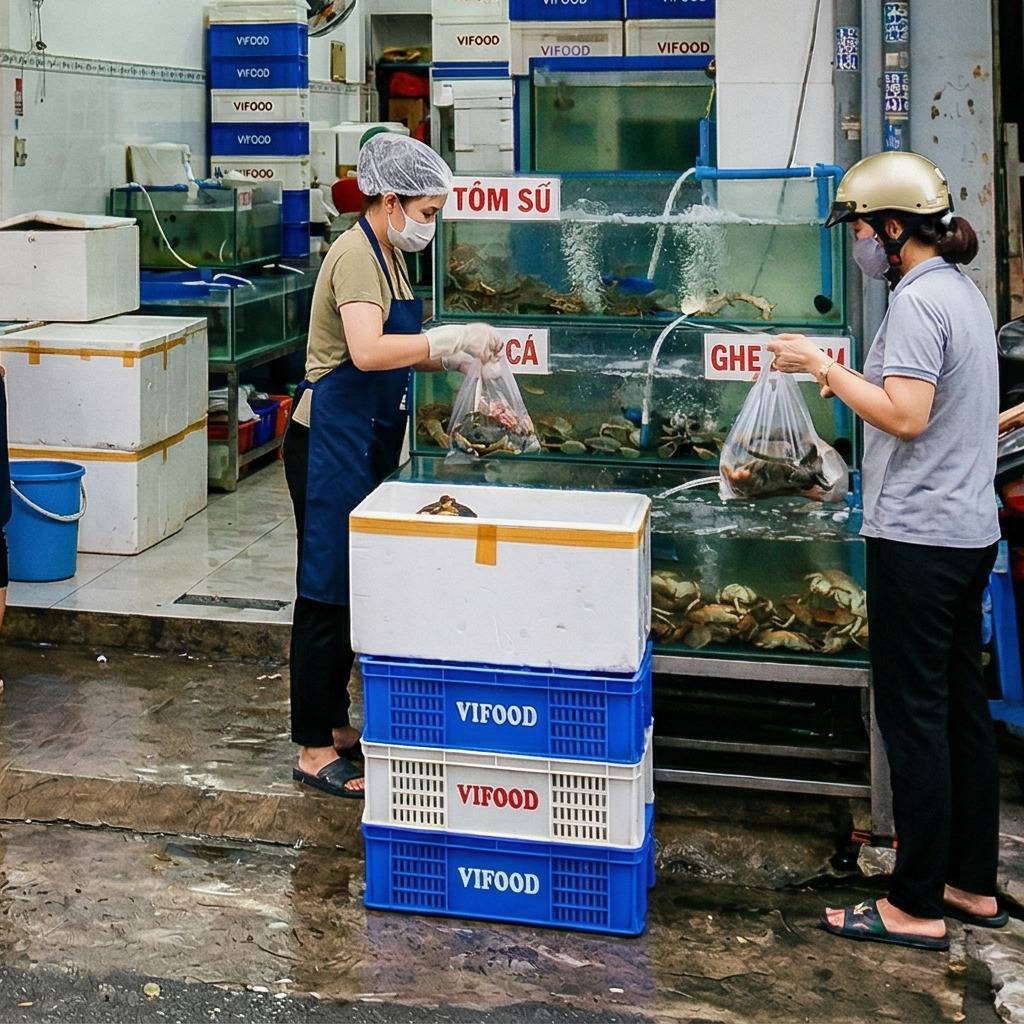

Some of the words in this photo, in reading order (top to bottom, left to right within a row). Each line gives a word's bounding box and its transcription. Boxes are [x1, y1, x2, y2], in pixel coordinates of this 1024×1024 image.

[456, 35, 500, 46] VIFOOD
[541, 45, 590, 56] VIFOOD
[657, 42, 710, 54] VIFOOD
[452, 180, 509, 212] TÔM
[505, 333, 539, 365] CÁ
[455, 701, 538, 726] VIFOOD
[456, 783, 540, 811] VIFOOD
[457, 866, 540, 895] VIFOOD
